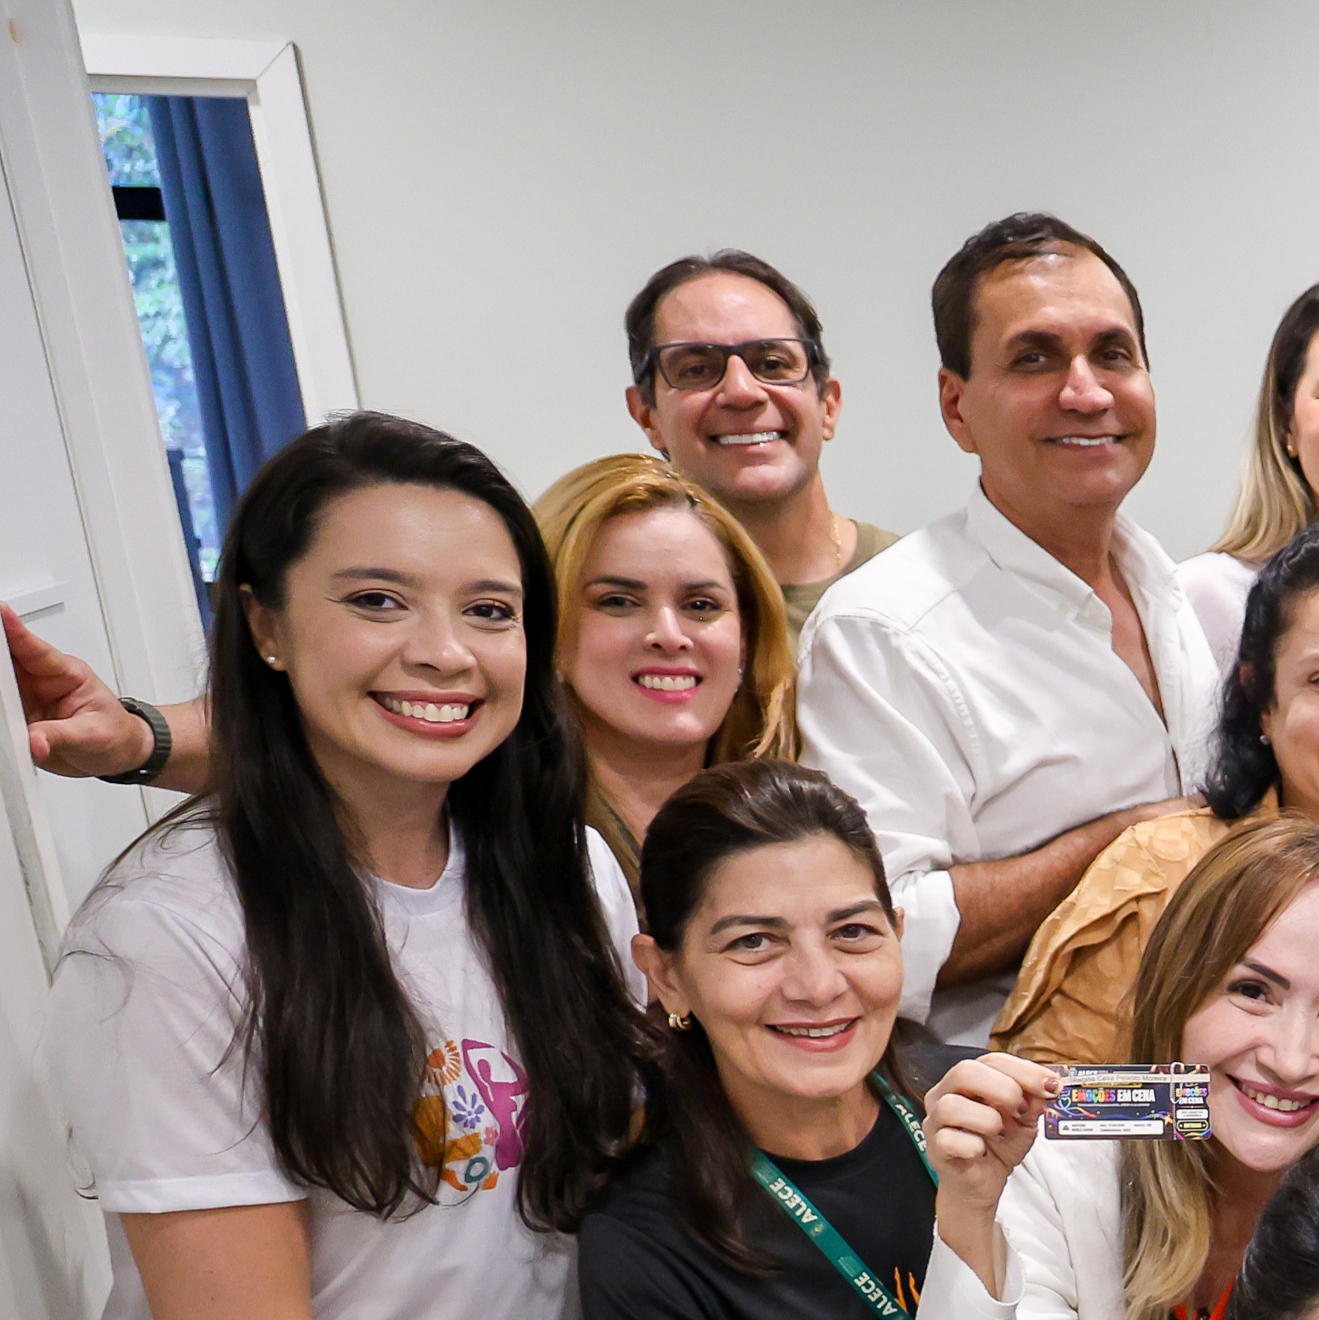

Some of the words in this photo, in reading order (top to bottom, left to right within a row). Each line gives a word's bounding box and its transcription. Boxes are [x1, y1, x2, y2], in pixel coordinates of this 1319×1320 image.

[1072, 1088, 1116, 1104] EMOÇÕES
[1117, 1089, 1132, 1102] EM
[1132, 1089, 1156, 1102] CENA
[896, 1104, 927, 1151] ALECE
[769, 1177, 818, 1224] ALECE
[854, 1272, 898, 1316] ALECE
